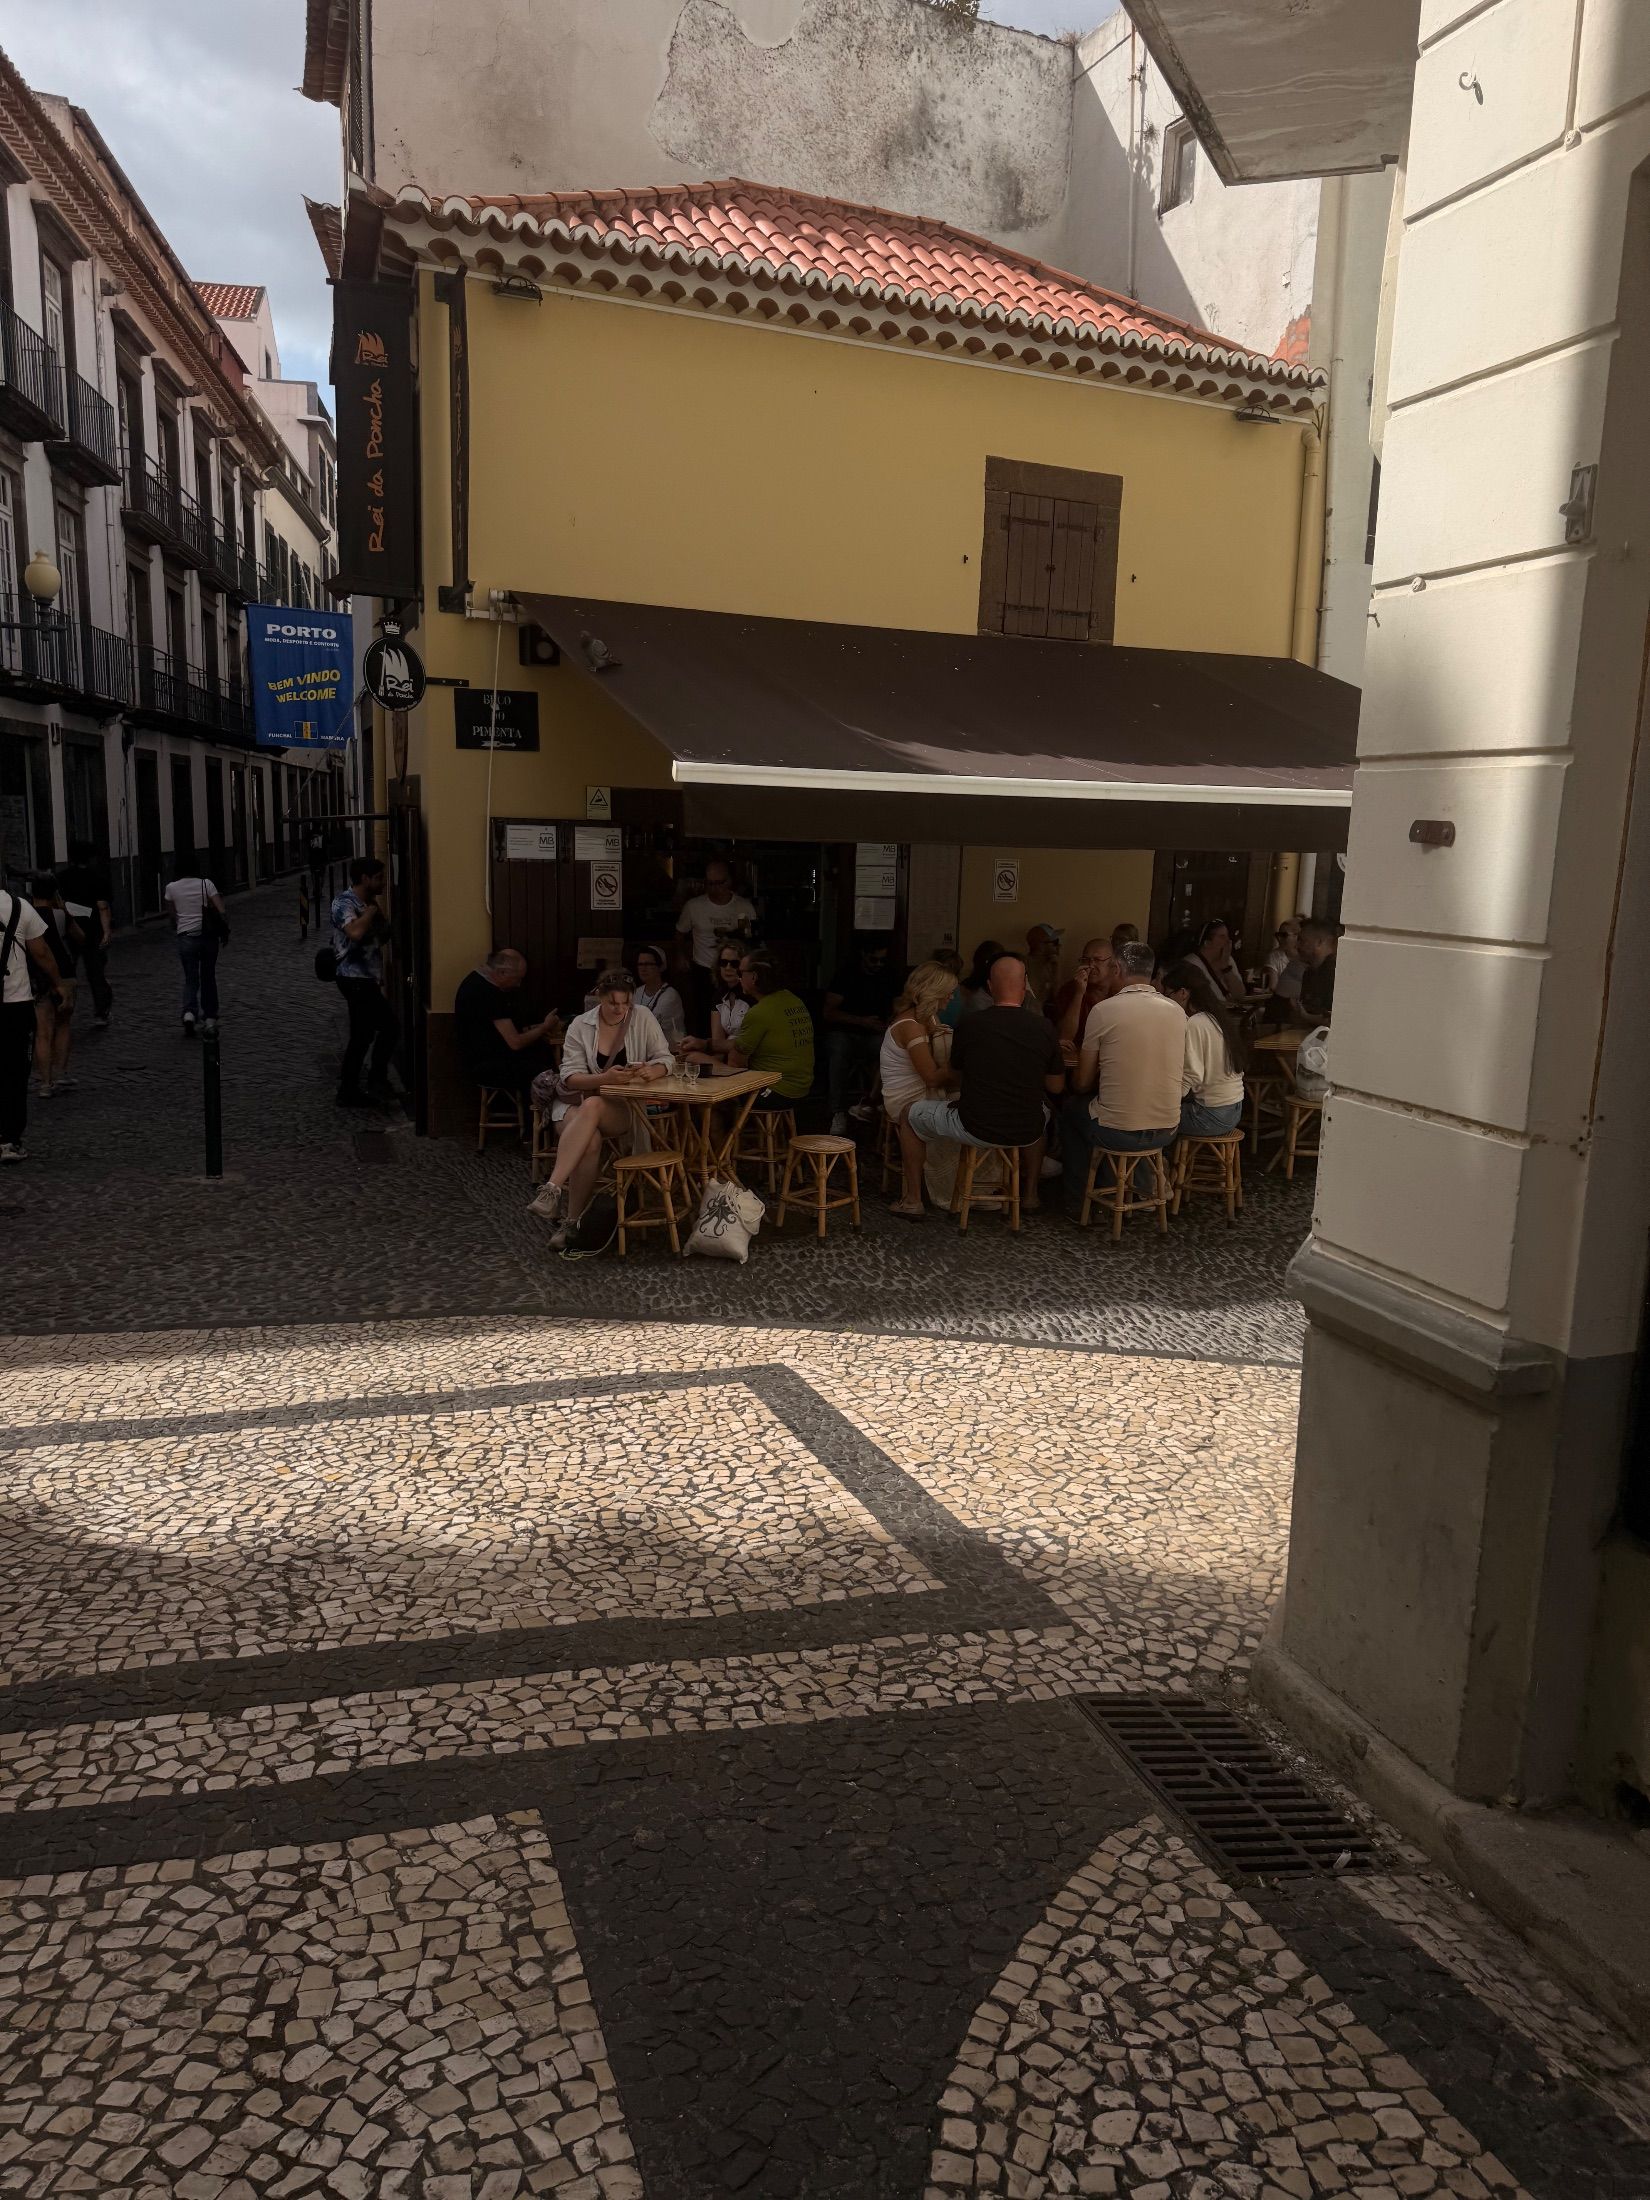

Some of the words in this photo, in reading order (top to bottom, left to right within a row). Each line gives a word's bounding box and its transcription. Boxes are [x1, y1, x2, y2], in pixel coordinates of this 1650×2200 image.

[363, 377, 384, 459] Poncha
[367, 468, 384, 497] da
[368, 506, 384, 552] Rei
[266, 623, 337, 640] PORTO
[267, 678, 294, 691] BEM
[296, 669, 341, 686] VINDO
[386, 677, 415, 692] Rei
[275, 687, 337, 703] WELCOME
[539, 836, 555, 846] MB
